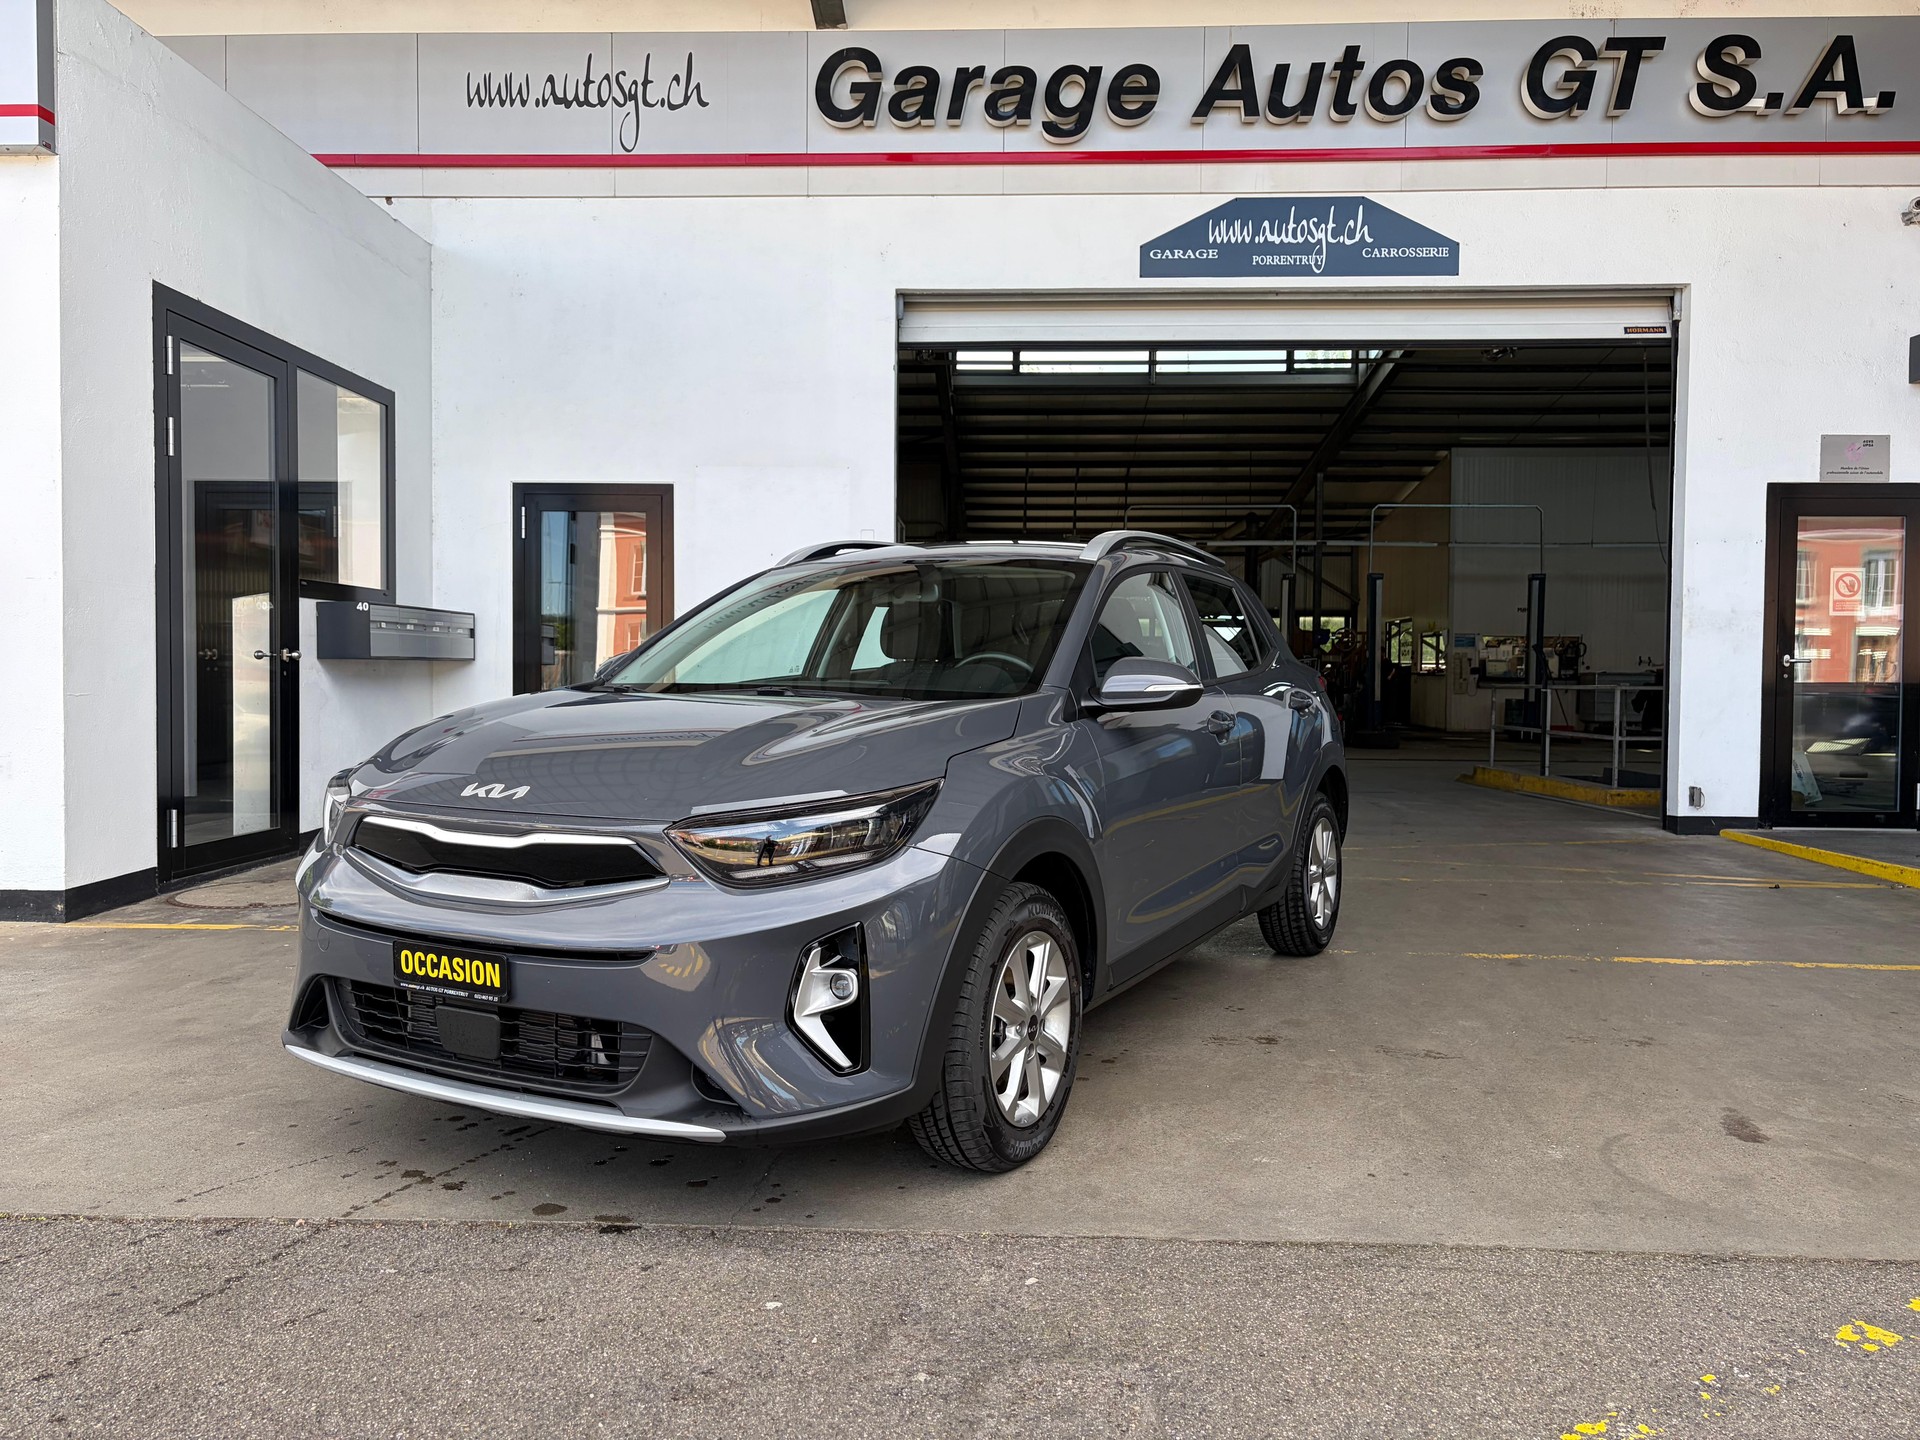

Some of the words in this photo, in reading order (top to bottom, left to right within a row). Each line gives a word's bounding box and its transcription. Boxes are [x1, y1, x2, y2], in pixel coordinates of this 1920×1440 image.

[814, 47, 1162, 144] Garage
[1191, 43, 1484, 124] Autos
[1521, 35, 1667, 119] GT
[1689, 34, 1897, 118] S.A.
[467, 52, 709, 152] www.autosgt.ch
[1208, 205, 1374, 273] www.autosgt.ch
[1150, 249, 1218, 259] GARAGE
[1252, 255, 1323, 265] PORRENTRUY
[1362, 247, 1449, 258] CARROSSERIE
[356, 602, 369, 611] 40
[461, 782, 531, 799] KIA
[400, 949, 501, 988] OCCASION
